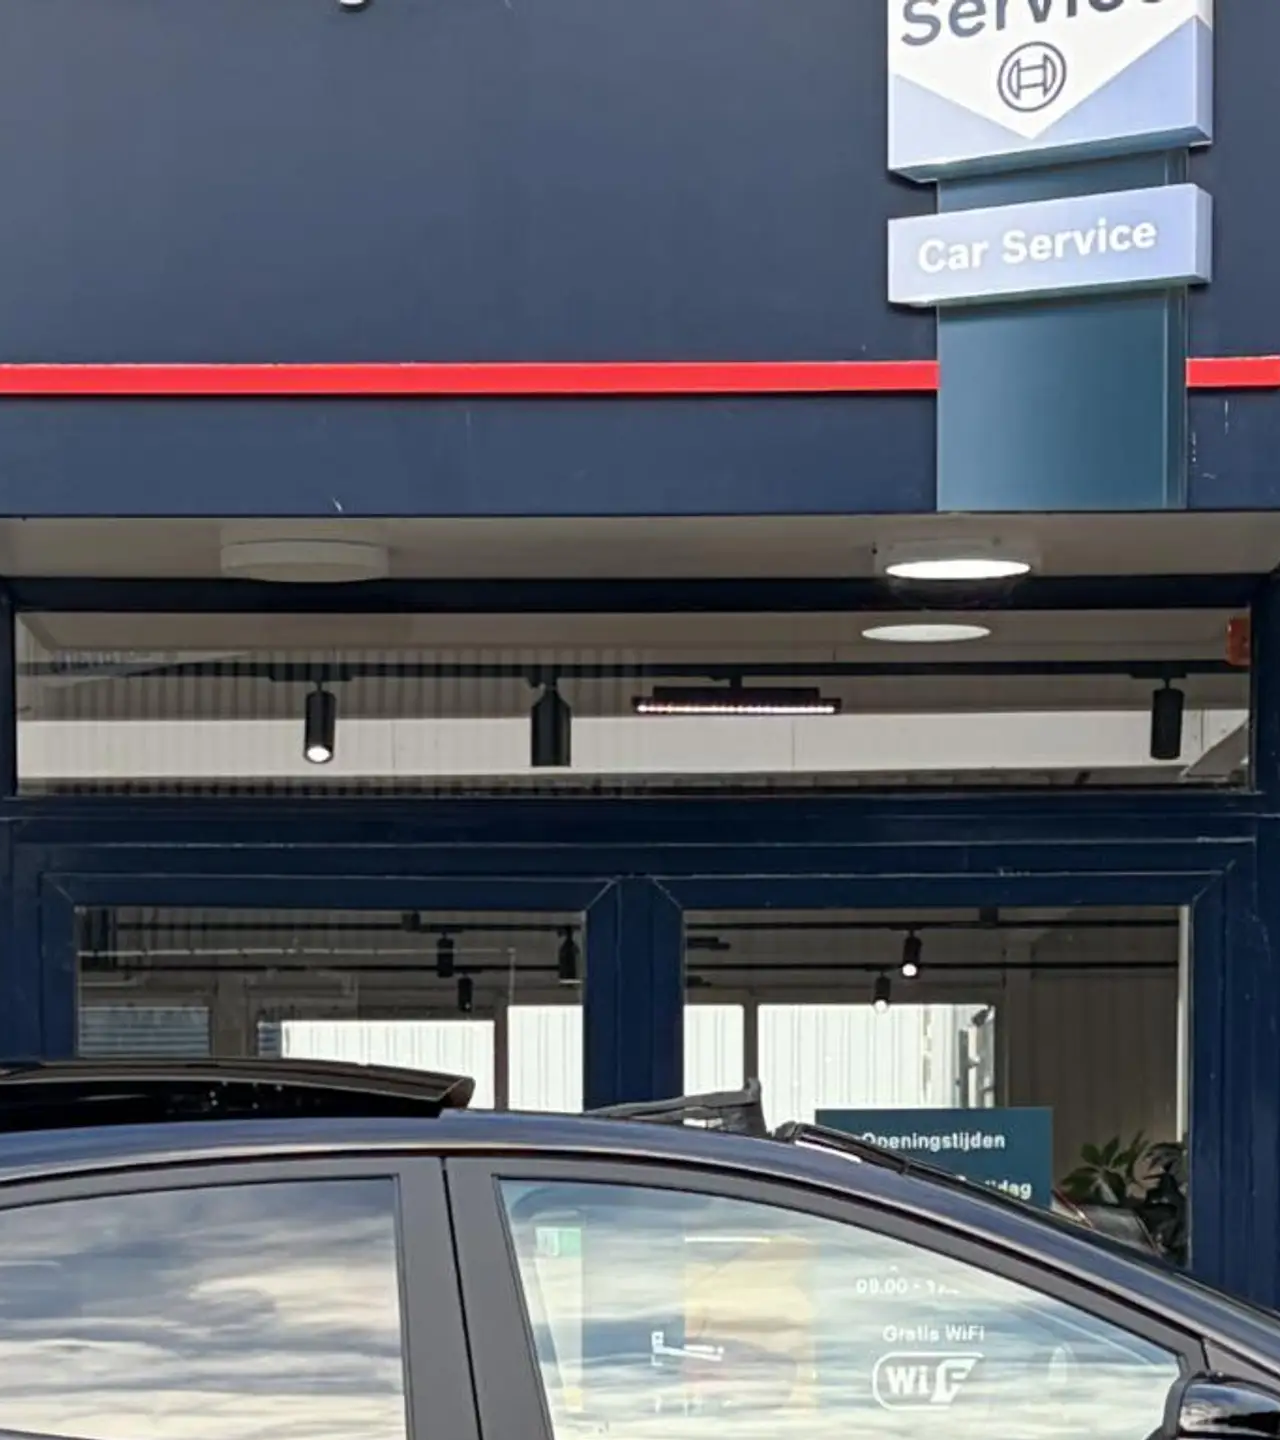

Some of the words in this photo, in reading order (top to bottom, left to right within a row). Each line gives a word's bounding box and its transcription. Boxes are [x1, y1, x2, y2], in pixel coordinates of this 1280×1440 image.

[918, 238, 989, 274] Car
[1002, 217, 1158, 265] Service
[882, 1324, 940, 1342] Gratis
[945, 1323, 986, 1342] WiFi
